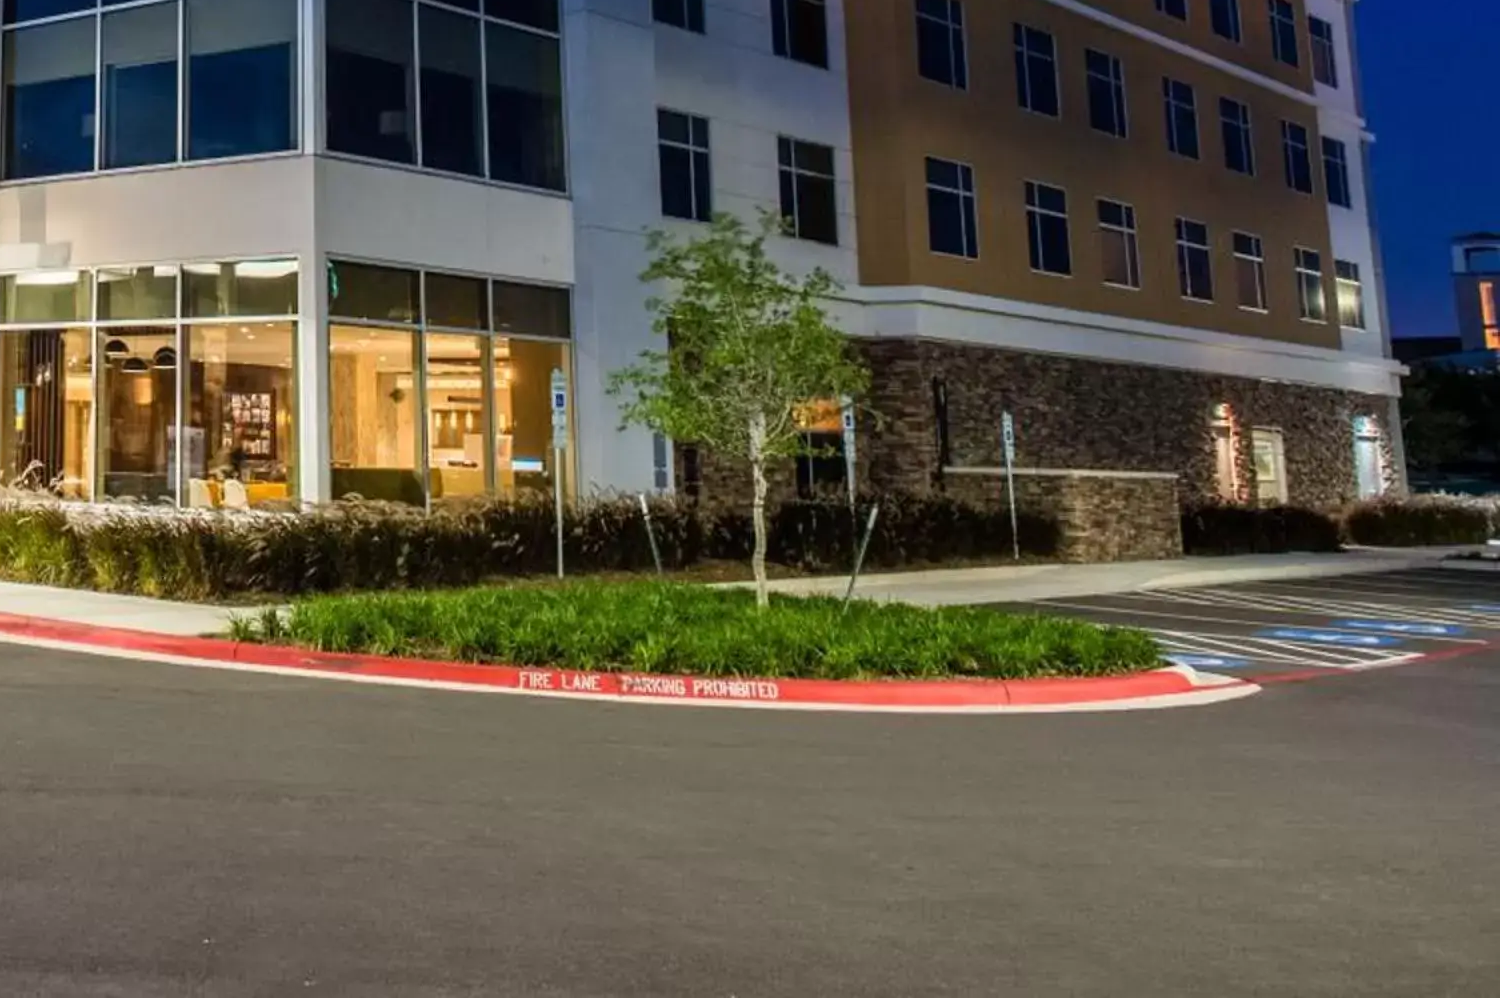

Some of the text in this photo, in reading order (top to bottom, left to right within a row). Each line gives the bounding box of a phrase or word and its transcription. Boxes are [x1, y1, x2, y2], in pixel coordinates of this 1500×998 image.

[519, 671, 779, 699] FIRE LANE PARKING PROHIBITED
